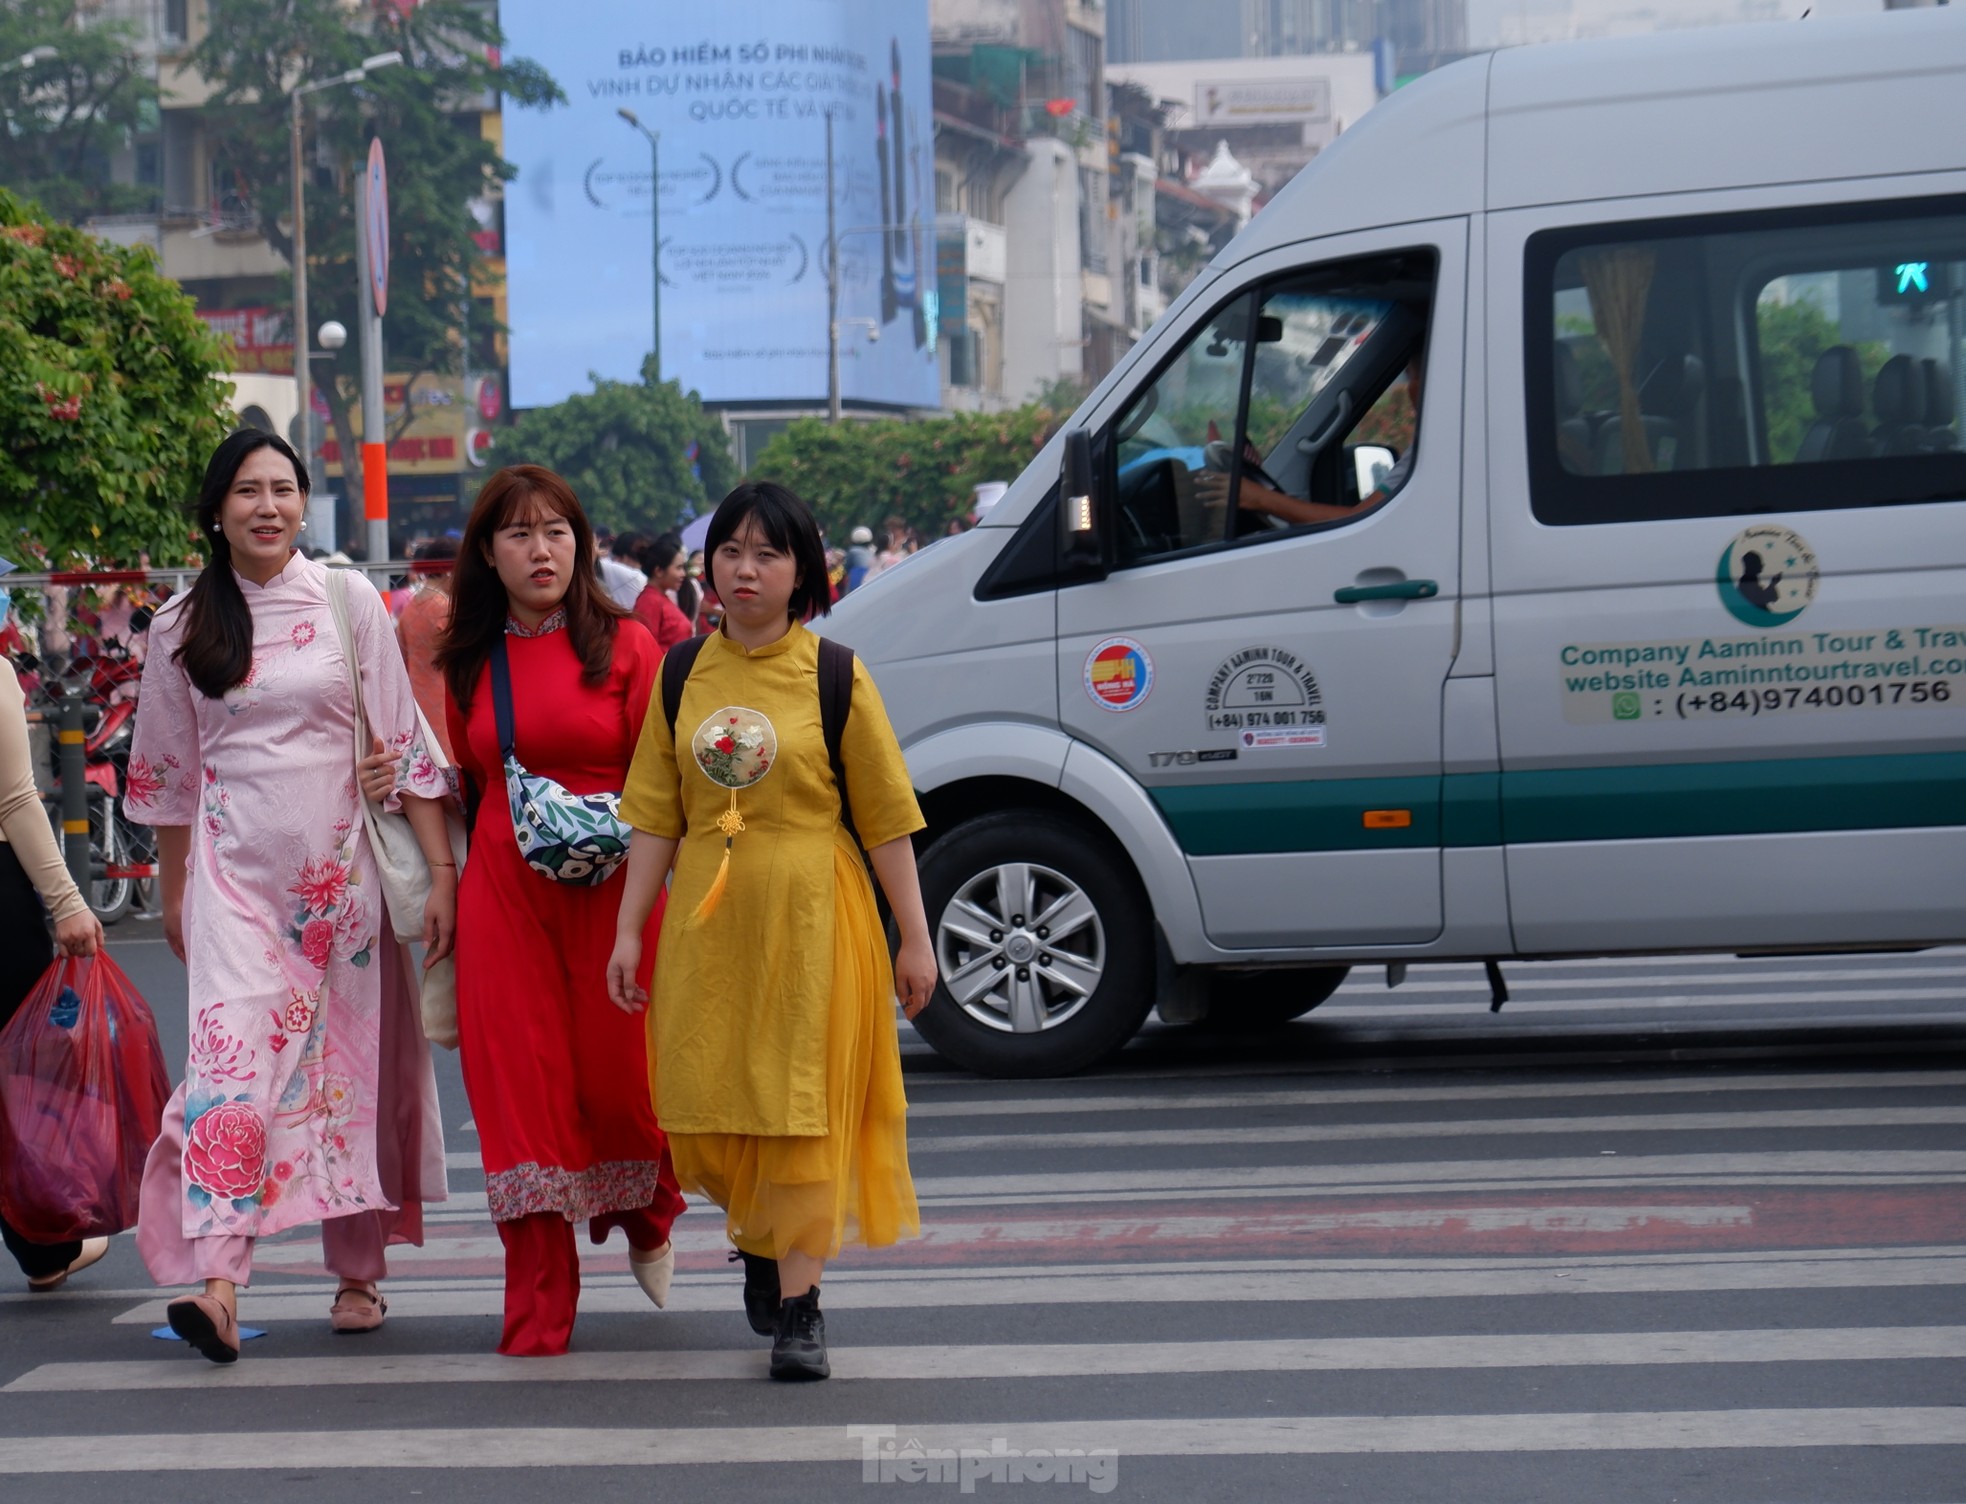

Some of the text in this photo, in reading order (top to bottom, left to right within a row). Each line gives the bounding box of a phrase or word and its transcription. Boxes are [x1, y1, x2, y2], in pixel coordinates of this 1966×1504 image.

[618, 41, 667, 70] BẢO
[671, 37, 732, 66] HIỂM
[738, 37, 769, 65] SỐ
[775, 43, 808, 64] PHI
[586, 77, 640, 98] VINH
[646, 72, 681, 98] DỰ
[760, 68, 802, 92] CÁC
[688, 95, 759, 124] QUỐC
[765, 94, 789, 120] TẾ
[1560, 644, 1691, 668] Company
[1698, 636, 1803, 660] Aaminn
[1812, 631, 1877, 654] Tour
[1884, 628, 1906, 651] &
[1206, 663, 1234, 711] COMPANY
[1270, 647, 1298, 669] TOUR
[1300, 671, 1322, 707] TRAVEL
[1565, 655, 1966, 693] website Aaminntourtravel.co
[1208, 712, 1244, 730] (+84)
[1247, 711, 1271, 726] 974
[1300, 709, 1326, 725] 756
